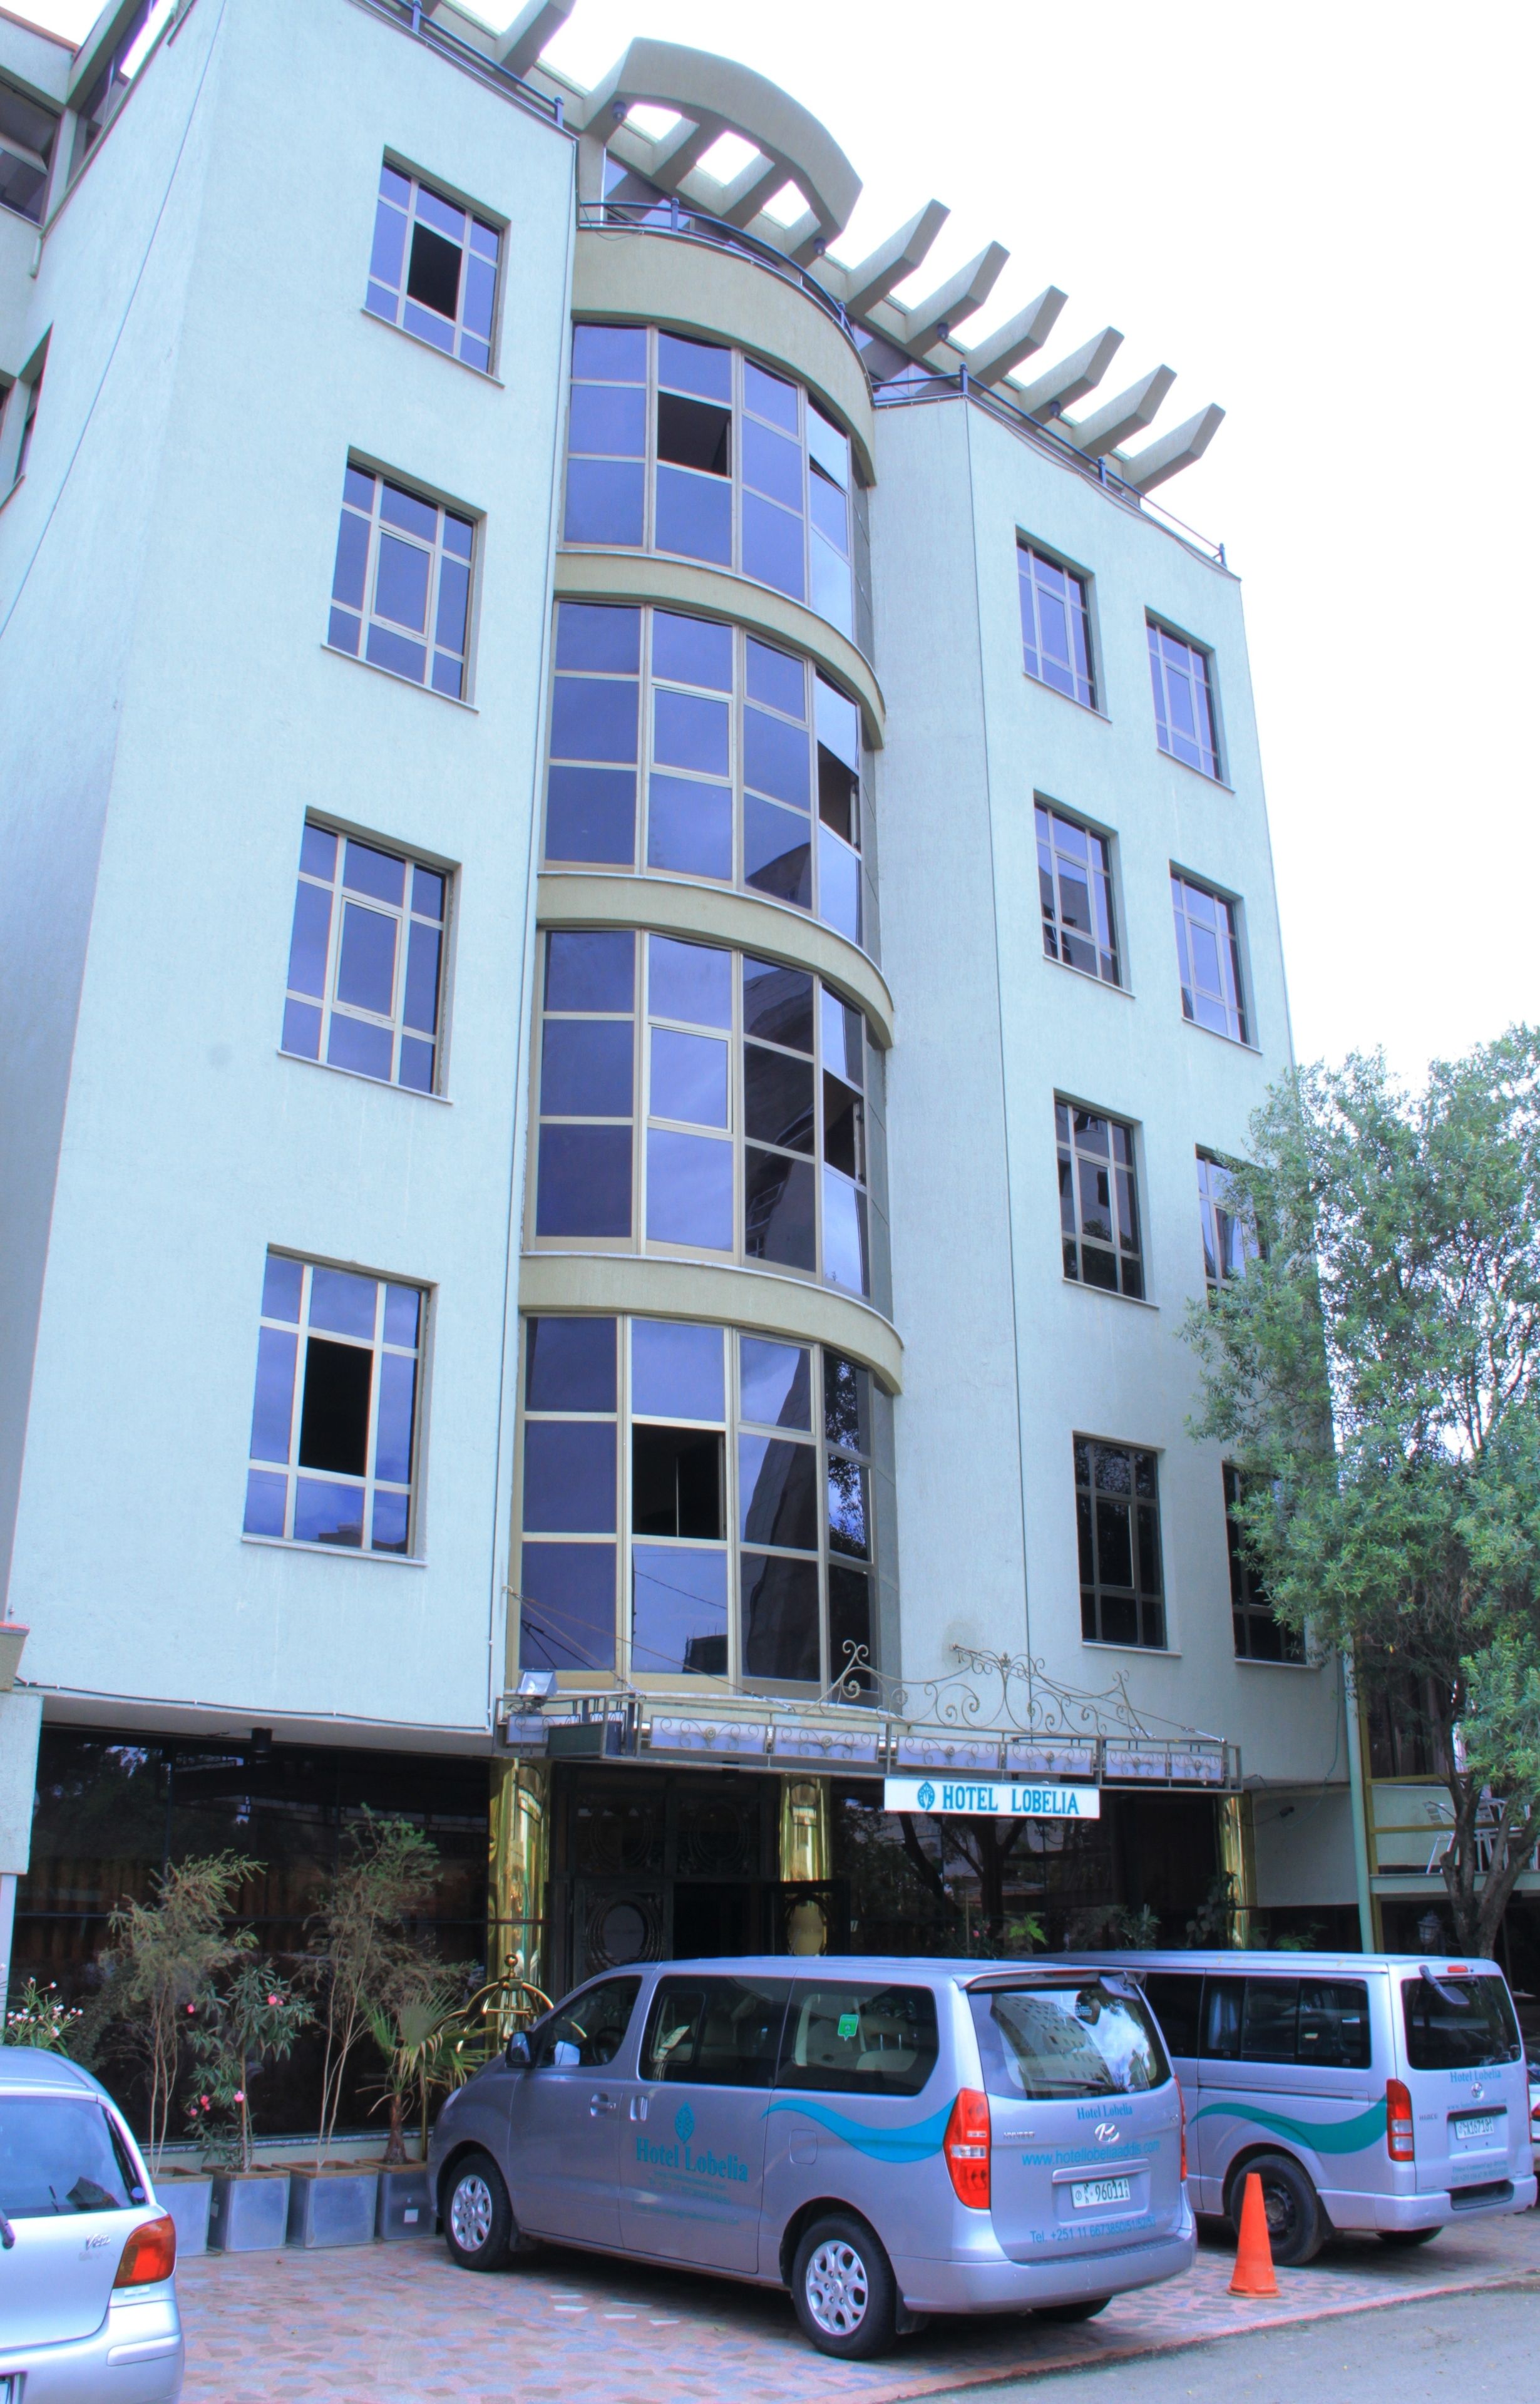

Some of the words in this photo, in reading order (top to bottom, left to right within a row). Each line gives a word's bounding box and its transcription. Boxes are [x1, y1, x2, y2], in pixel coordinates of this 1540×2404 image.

[942, 1785, 998, 1811] HOTEL
[1011, 1788, 1079, 1815] LOBELIA
[1450, 2071, 1472, 2083] Hotel
[1474, 2067, 1502, 2080] Lobelia
[1077, 2105, 1101, 2120] Hotel
[1103, 2103, 1132, 2117] Lobelia
[636, 2136, 679, 2169] Hotel
[685, 2145, 748, 2182] Lobelia
[1095, 2181, 1124, 2202] 96011
[1030, 2230, 1046, 2243] Tel.
[1051, 2227, 1074, 2241] +251
[1078, 2226, 1087, 2239] 11
